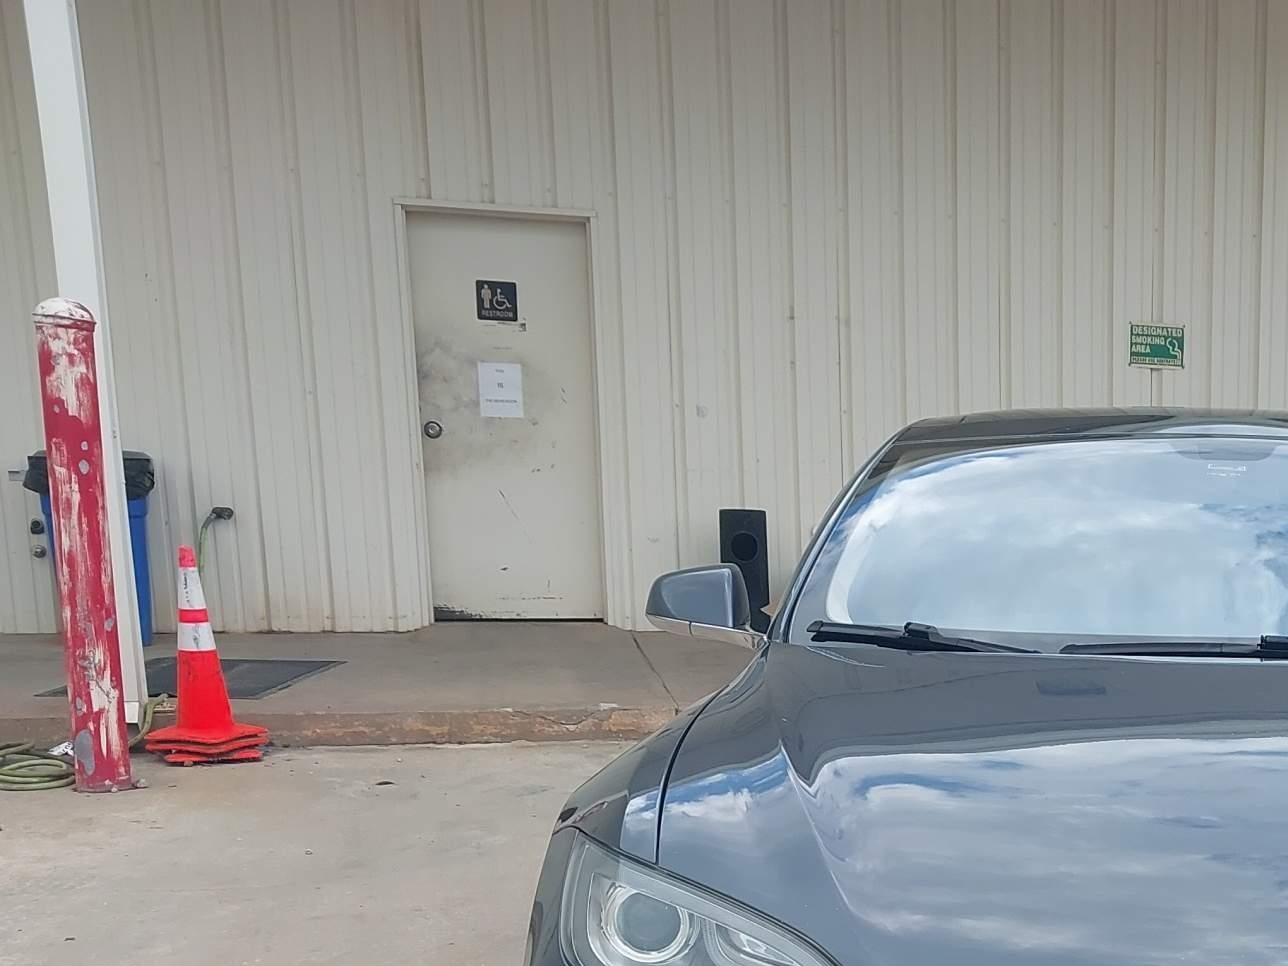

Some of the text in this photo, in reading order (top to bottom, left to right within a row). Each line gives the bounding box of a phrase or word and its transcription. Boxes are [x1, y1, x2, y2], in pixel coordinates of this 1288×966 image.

[481, 309, 514, 318] RESTROOM
[1132, 326, 1183, 337] DESIGNATED
[1131, 335, 1166, 345] SMOKING
[1131, 344, 1151, 353] AREA
